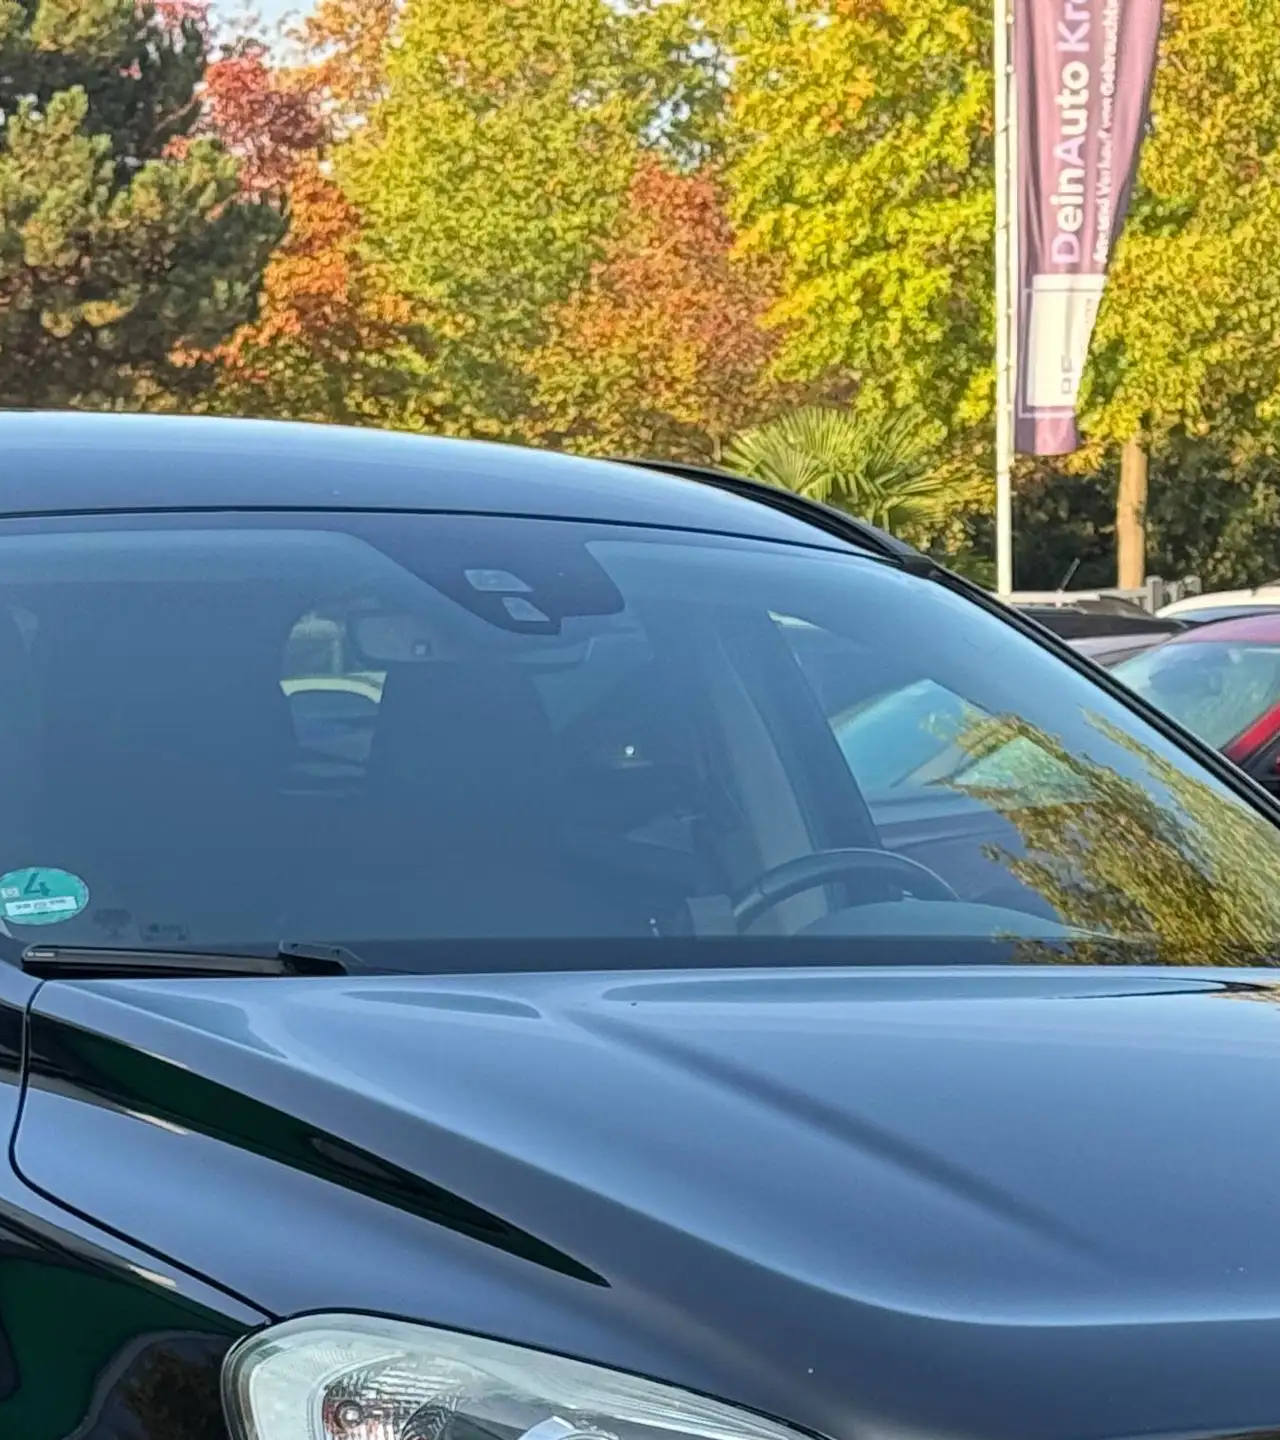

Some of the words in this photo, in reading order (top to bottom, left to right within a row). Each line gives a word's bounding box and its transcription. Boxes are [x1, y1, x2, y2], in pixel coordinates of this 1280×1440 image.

[1056, 0, 1091, 52] Kr
[1050, 61, 1090, 264] DeinAuto
[24, 871, 51, 897] 4
